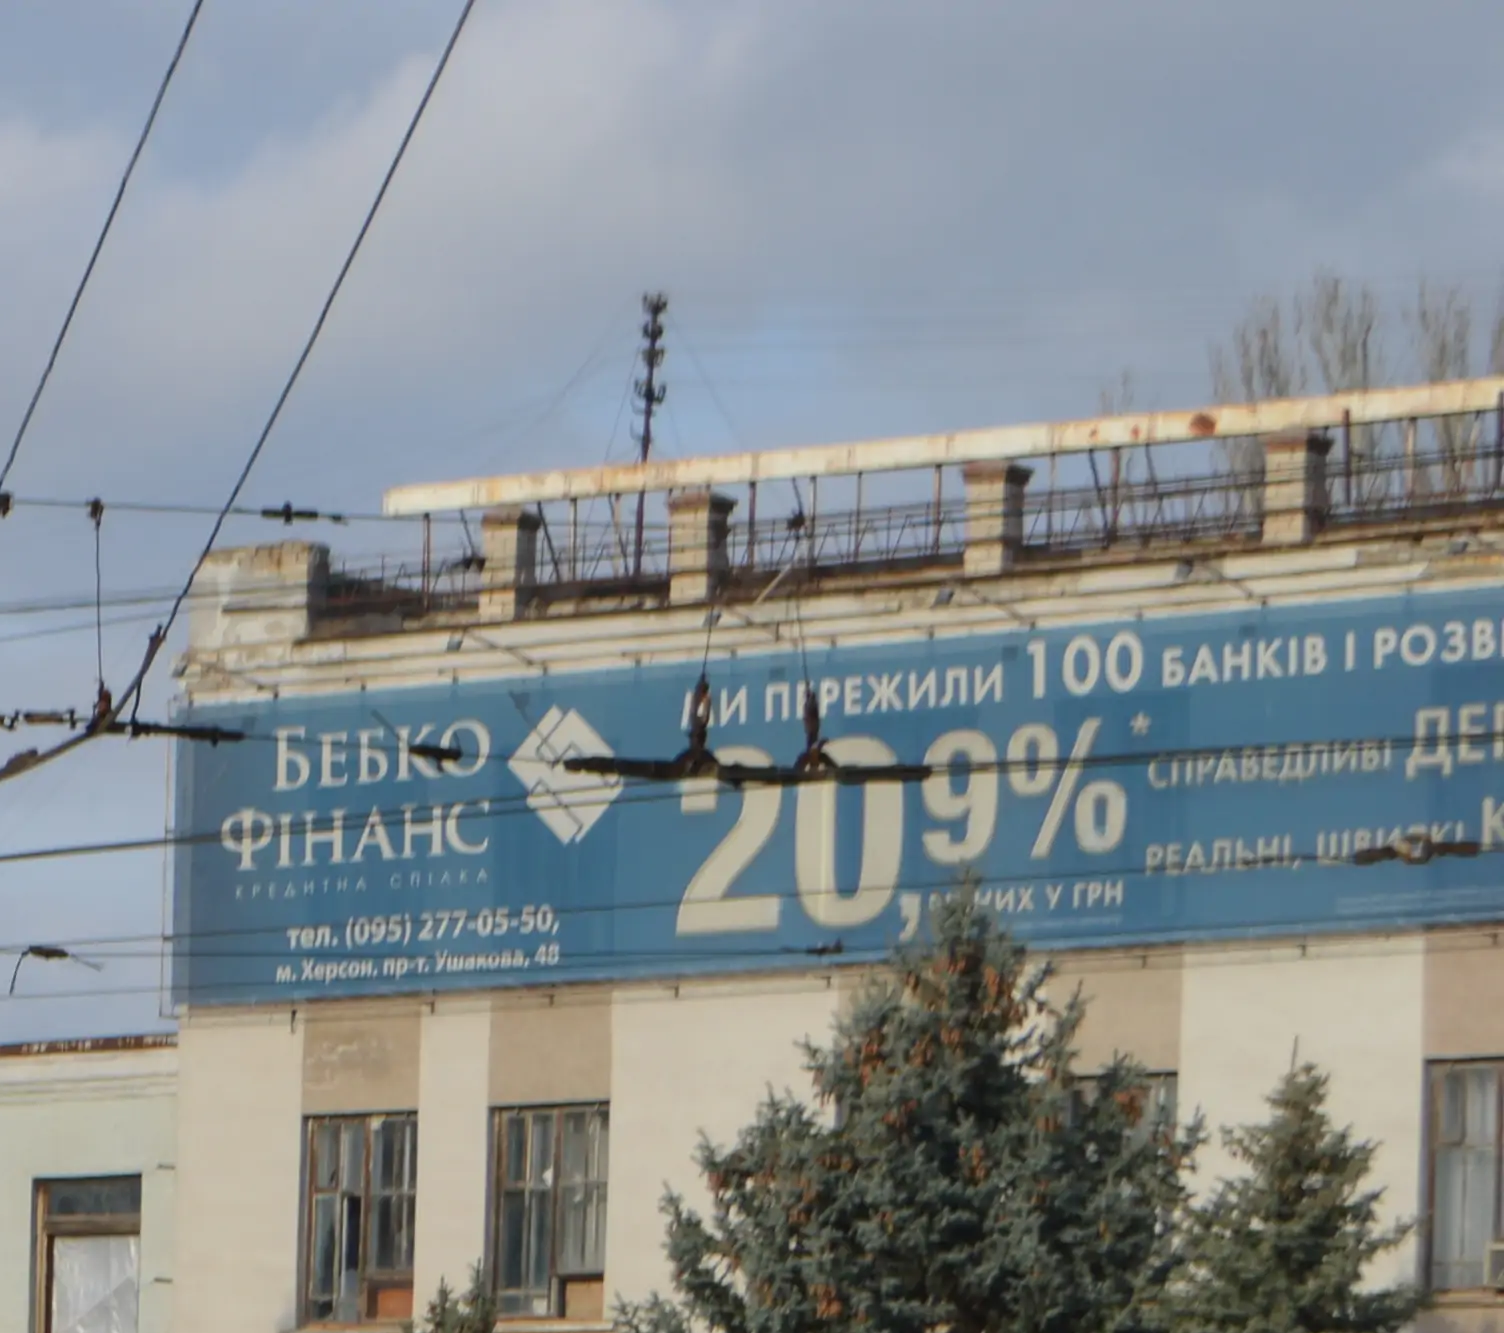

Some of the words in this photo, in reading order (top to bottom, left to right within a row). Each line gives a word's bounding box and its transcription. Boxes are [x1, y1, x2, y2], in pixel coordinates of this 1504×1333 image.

[1026, 630, 1144, 698] 100
[1162, 634, 1328, 688] БАНКІВ
[1345, 630, 1356, 672] І
[1373, 617, 1504, 669] РОЗВ
[273, 718, 491, 792] БЕБКО
[1147, 739, 1392, 789] СПРАВЕДЛИВІ
[221, 800, 489, 872] ФІНАНС
[1145, 834, 1303, 876] РЕАЛЬНІ,
[1072, 880, 1124, 909] ГРН
[287, 925, 339, 950] тел.
[345, 915, 412, 949] (095)
[418, 904, 561, 943] 277-05-50,
